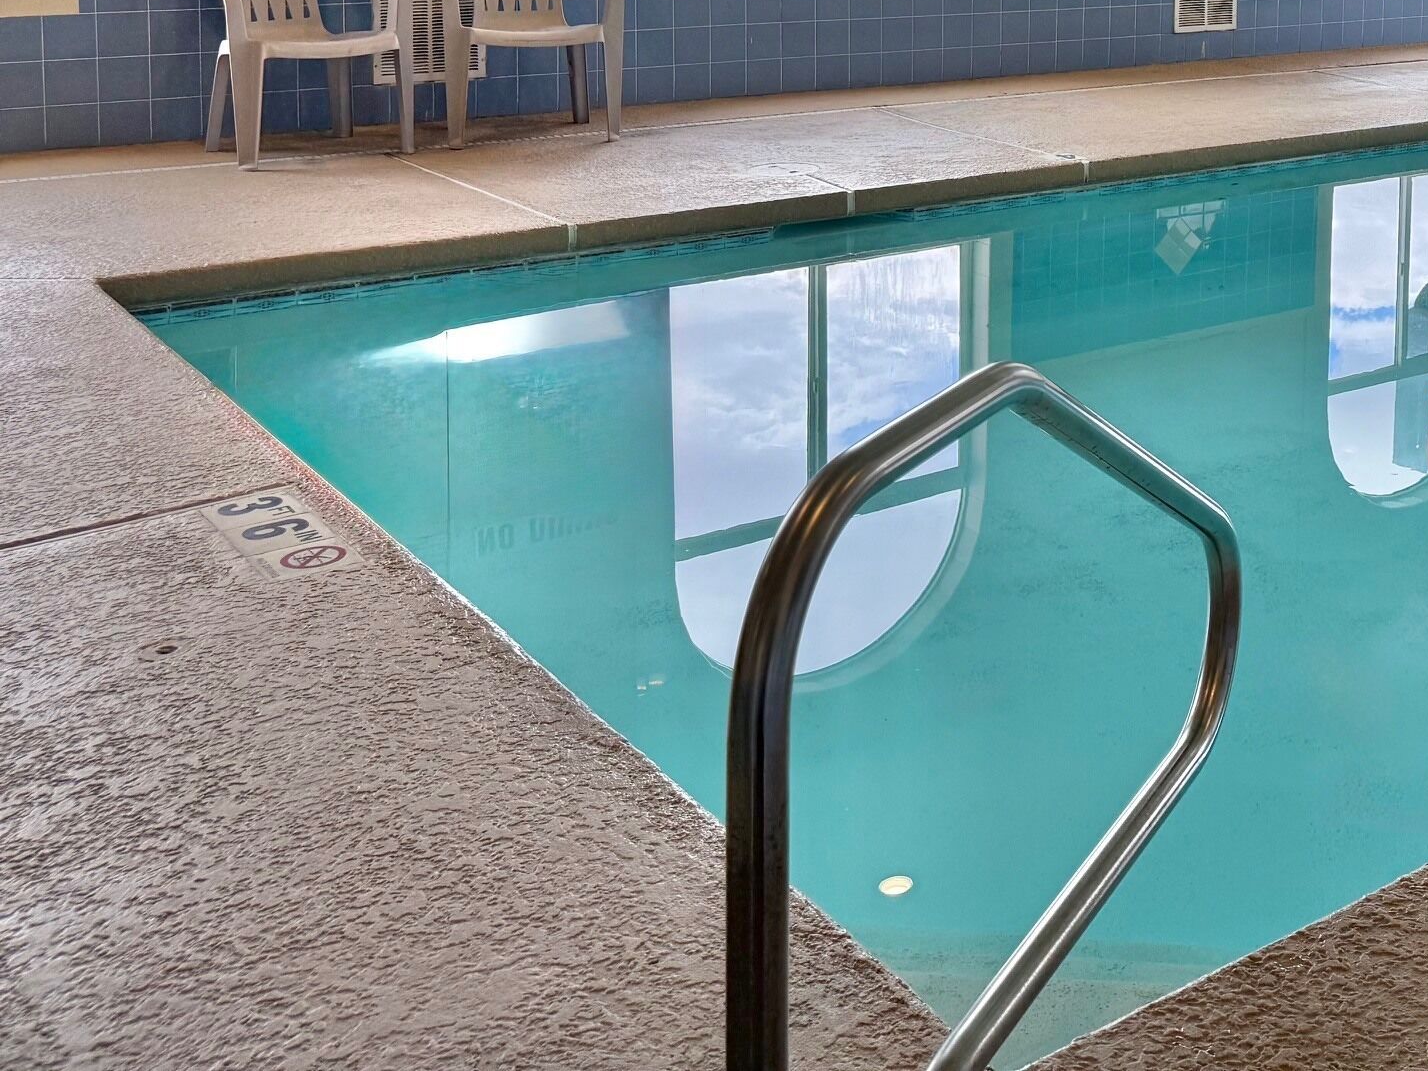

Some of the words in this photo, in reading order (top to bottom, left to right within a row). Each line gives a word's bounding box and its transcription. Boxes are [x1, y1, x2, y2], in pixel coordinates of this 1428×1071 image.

[218, 496, 283, 516] 3
[267, 506, 296, 516] FT
[242, 518, 310, 540] 6
[294, 530, 322, 542] IN
